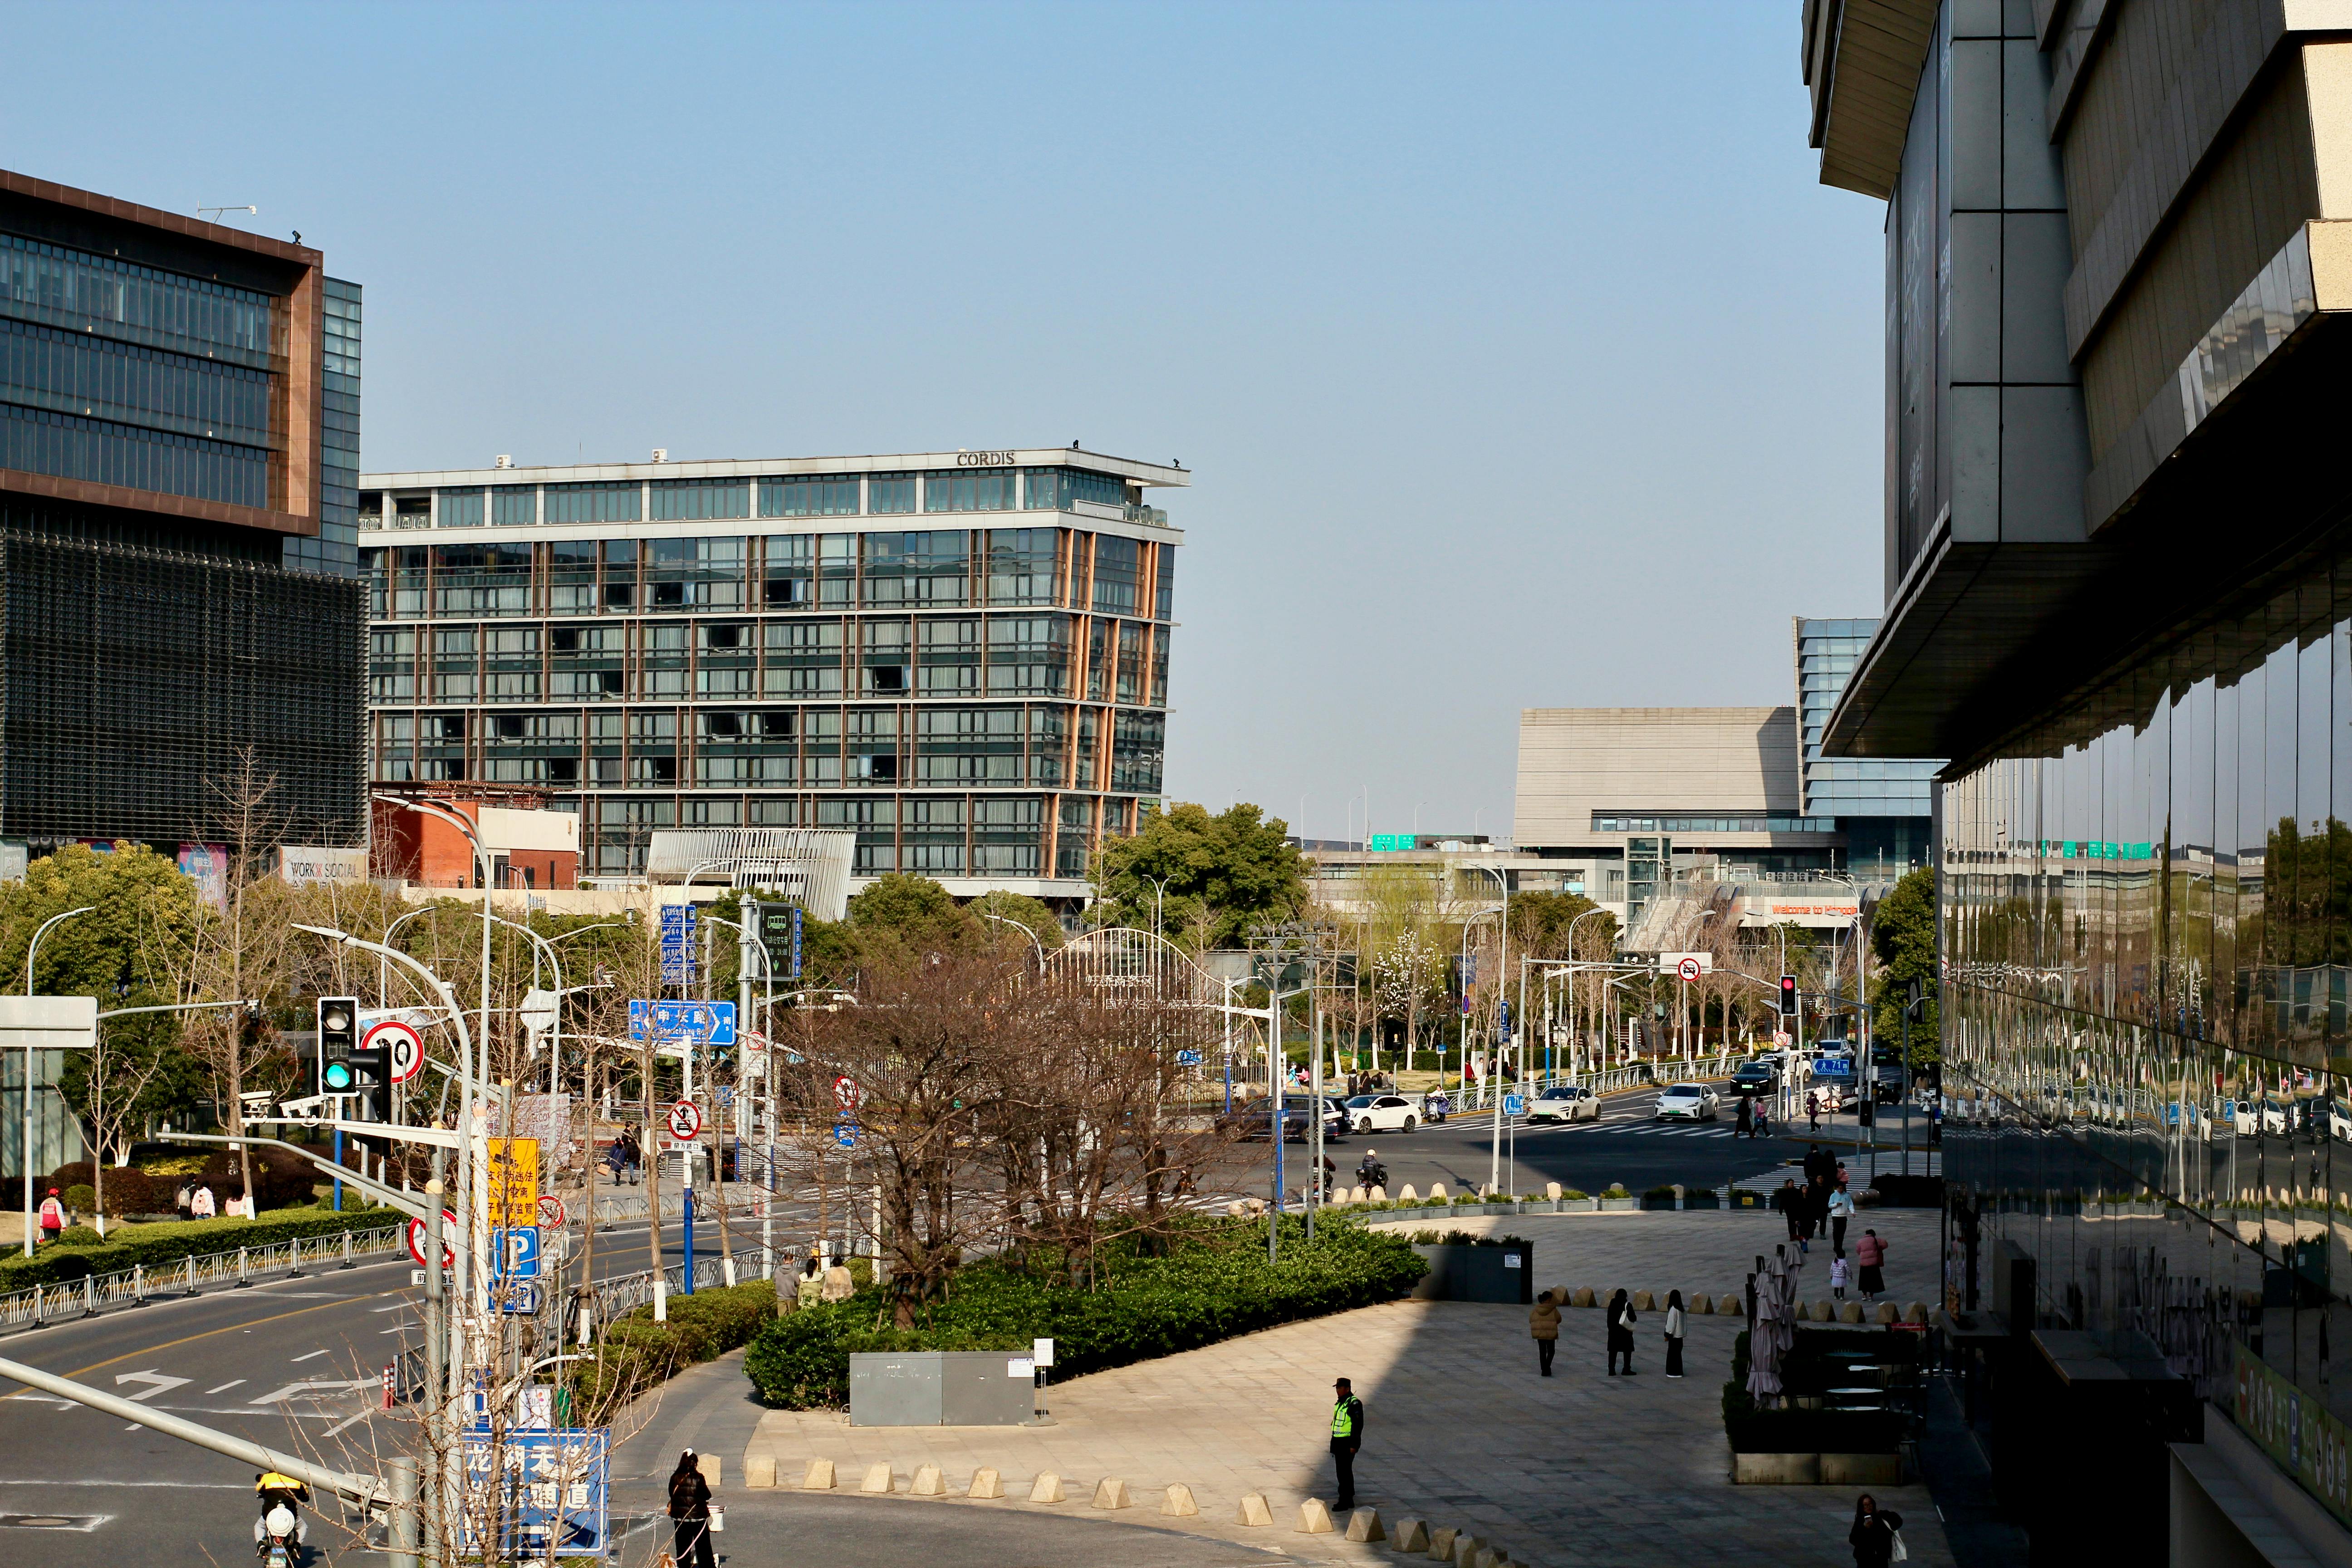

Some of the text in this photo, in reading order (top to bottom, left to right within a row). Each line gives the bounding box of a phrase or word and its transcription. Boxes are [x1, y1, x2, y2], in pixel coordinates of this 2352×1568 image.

[957, 452, 1014, 466] CORDIS
[325, 863, 358, 877] SOCIAL
[1772, 905, 1810, 914] Welcome
[1813, 906, 1823, 914] to
[723, 1016, 731, 1025] 南
[1502, 1005, 1507, 1023] P
[377, 1038, 411, 1066] 0
[505, 1236, 529, 1270] P
